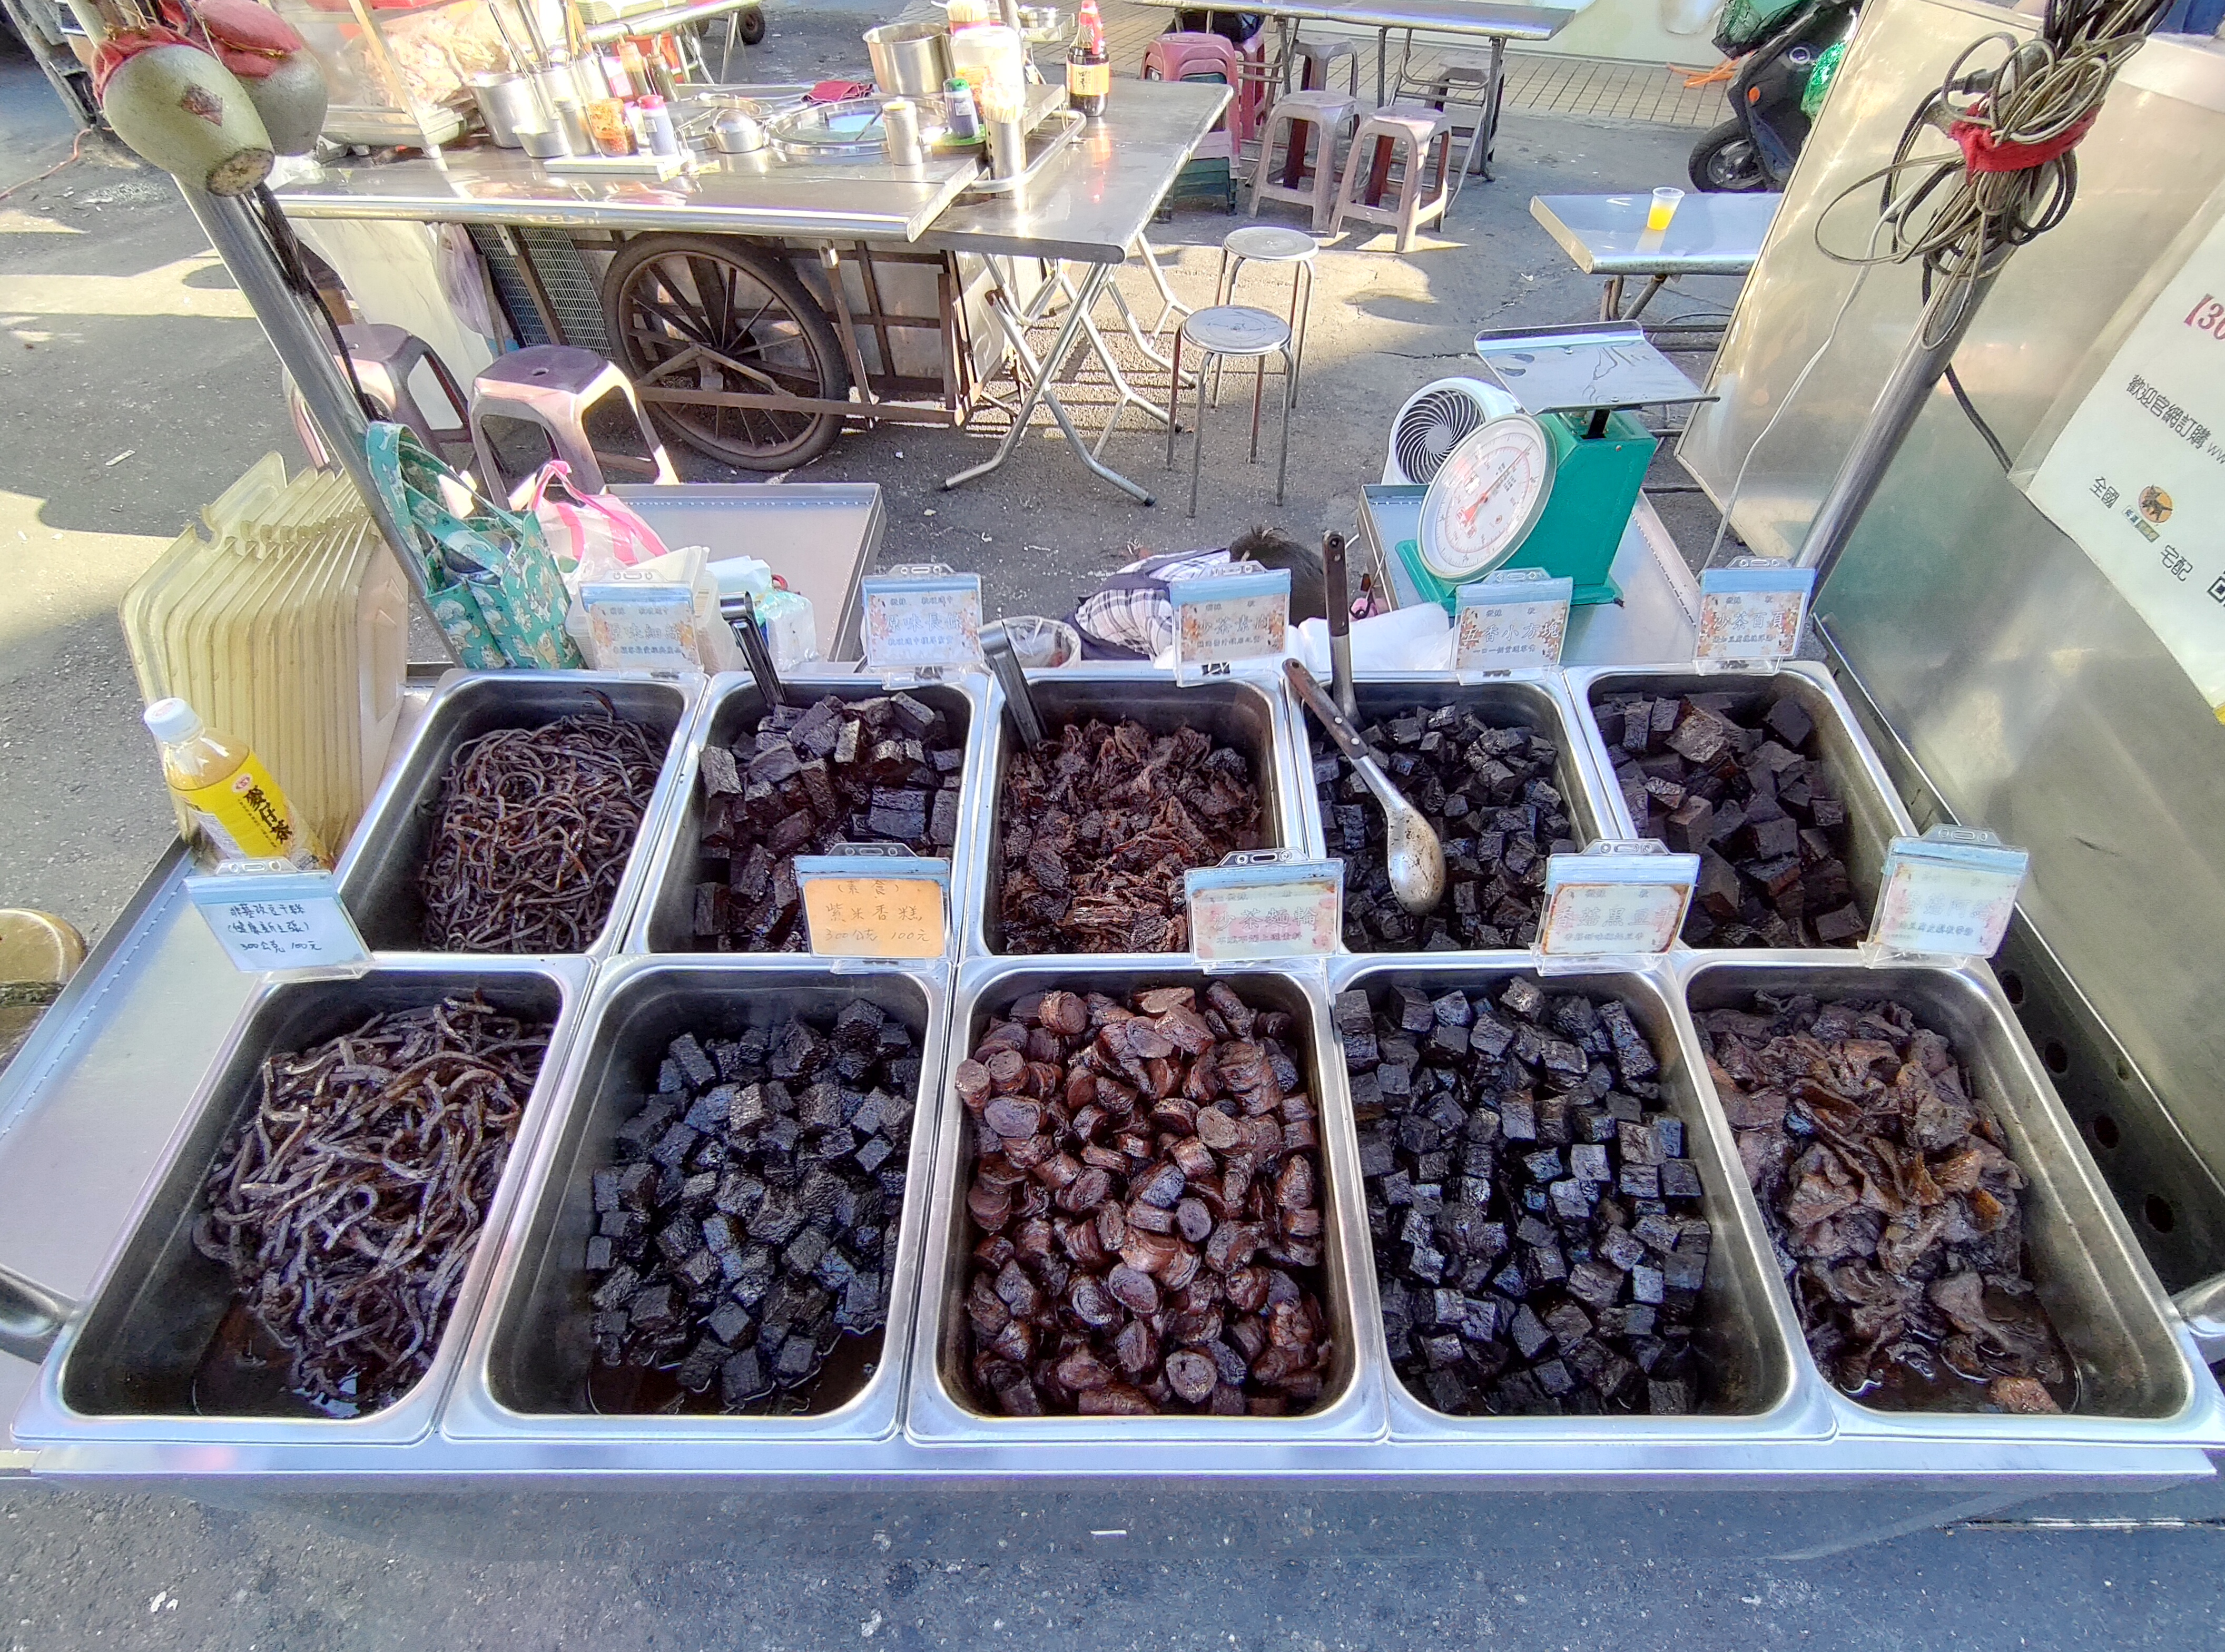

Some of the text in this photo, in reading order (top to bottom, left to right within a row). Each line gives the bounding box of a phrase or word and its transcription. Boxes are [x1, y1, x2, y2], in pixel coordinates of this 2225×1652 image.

[2126, 375, 2211, 449] 歡迎官網訂購
[2089, 476, 2193, 581] 全國 宅配
[1713, 611, 1785, 631] 沙茶百頁
[1462, 622, 1559, 643] 五香小方塊
[825, 902, 923, 922] 紫米香糕
[1213, 906, 1318, 931] 沙茶麵輪
[1553, 906, 1677, 927] 香菇黑豆干
[825, 928, 930, 942] 300公克 100元
[240, 940, 322, 953] 300公克 100元
